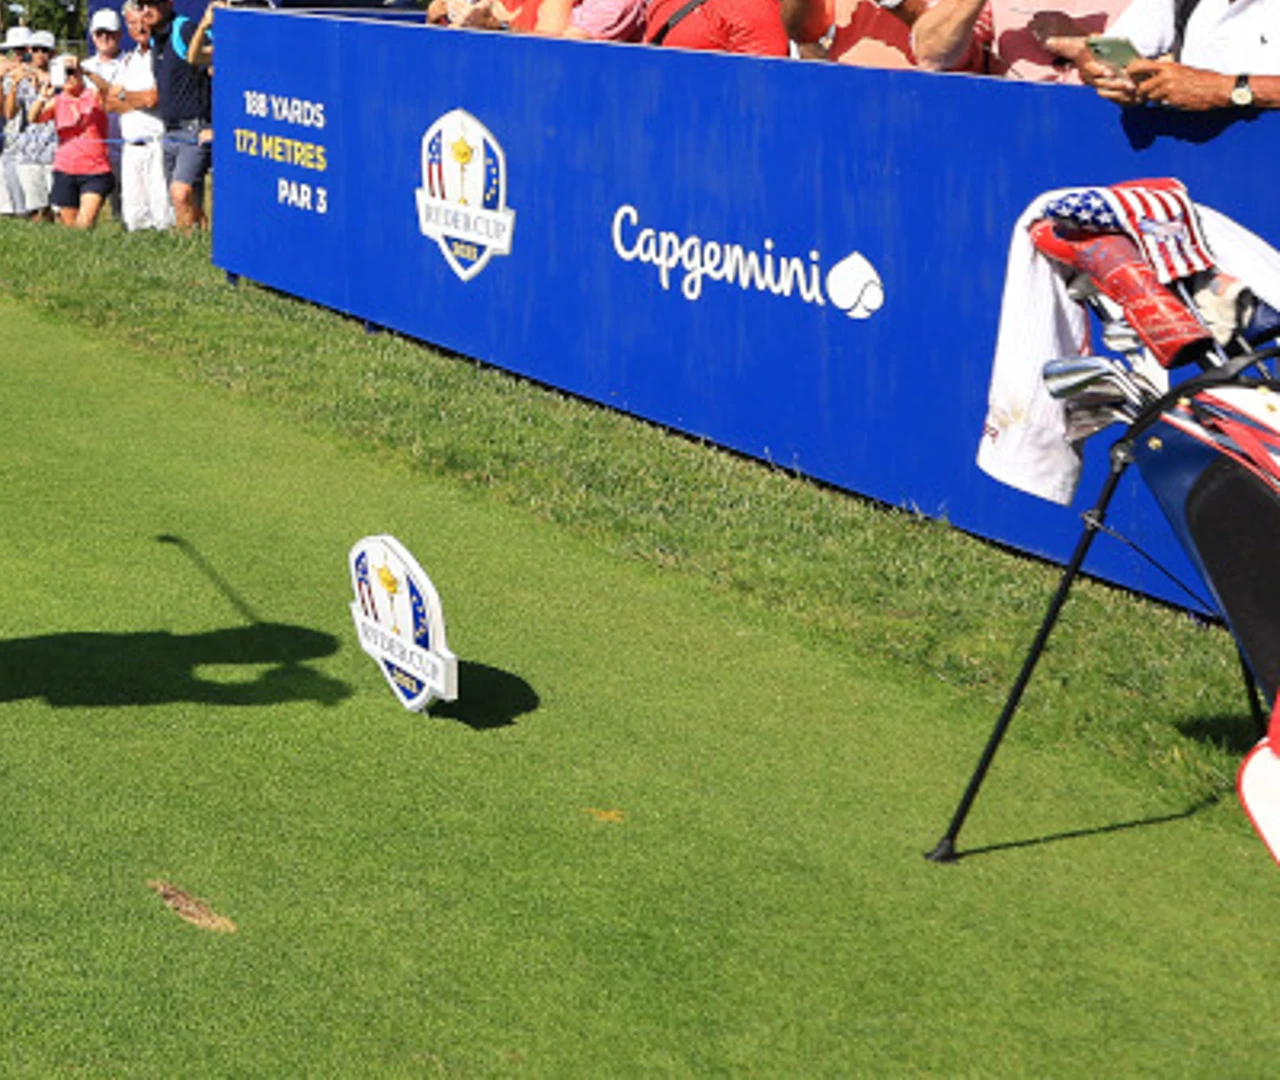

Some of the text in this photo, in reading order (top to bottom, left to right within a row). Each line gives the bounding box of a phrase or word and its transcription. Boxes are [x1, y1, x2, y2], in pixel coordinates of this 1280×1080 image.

[244, 90, 325, 128] 188 YARDS
[234, 128, 327, 171] 172 METRES
[278, 178, 327, 214] PAR 3
[611, 203, 826, 305] Capgemini
